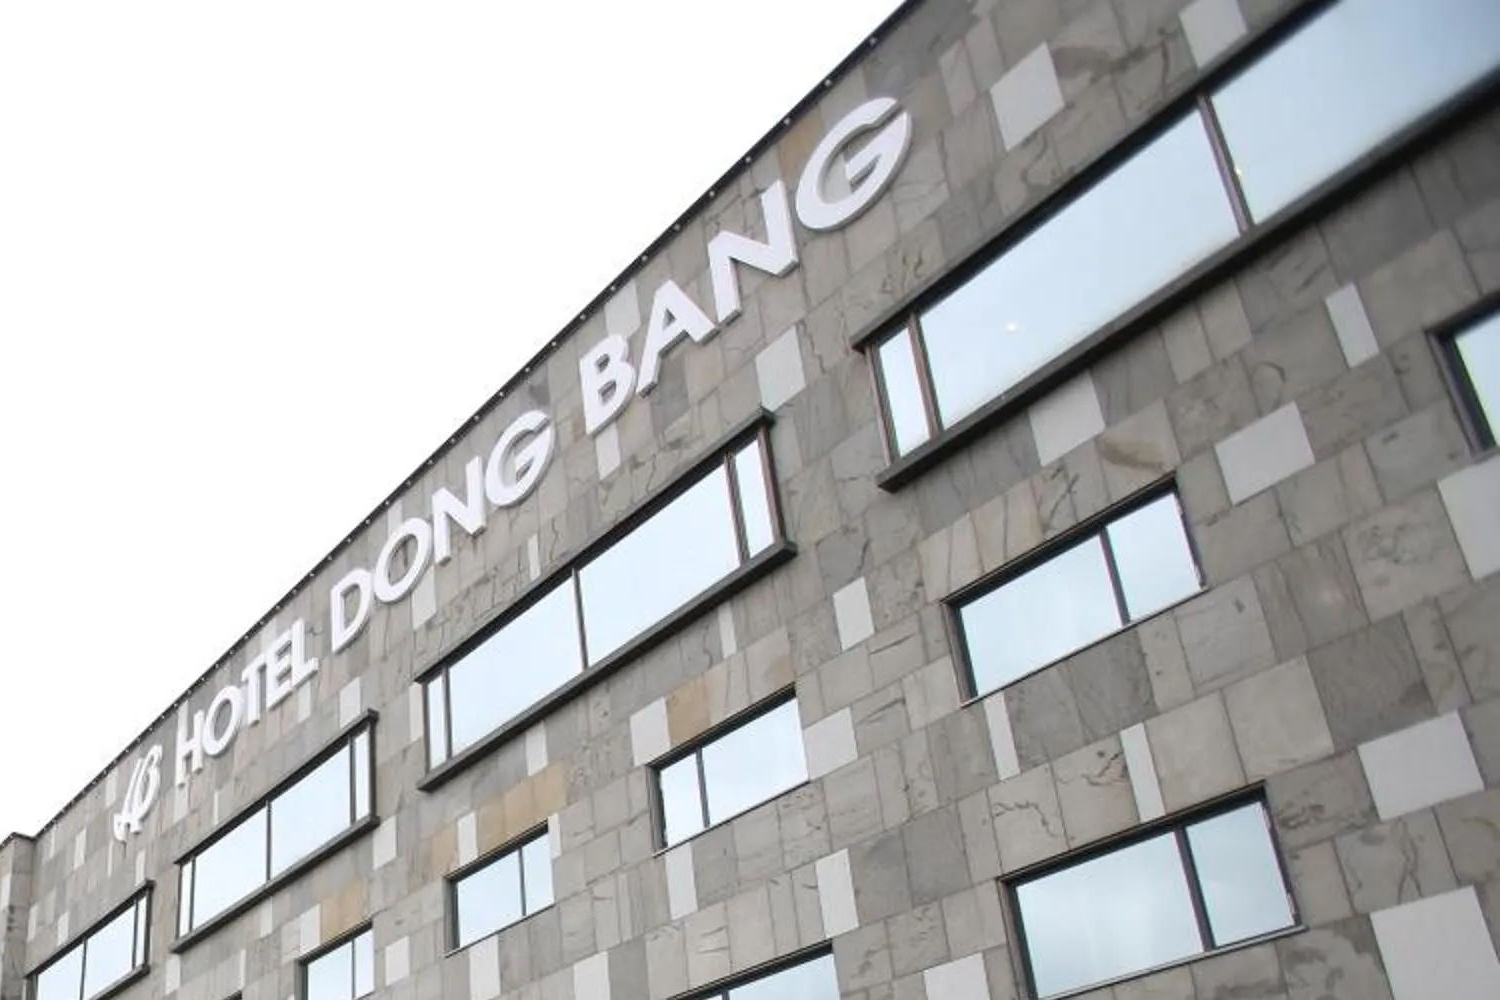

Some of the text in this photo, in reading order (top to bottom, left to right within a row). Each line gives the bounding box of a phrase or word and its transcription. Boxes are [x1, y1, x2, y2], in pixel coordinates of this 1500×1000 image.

[174, 97, 913, 787] HOTEL DONG BANG
